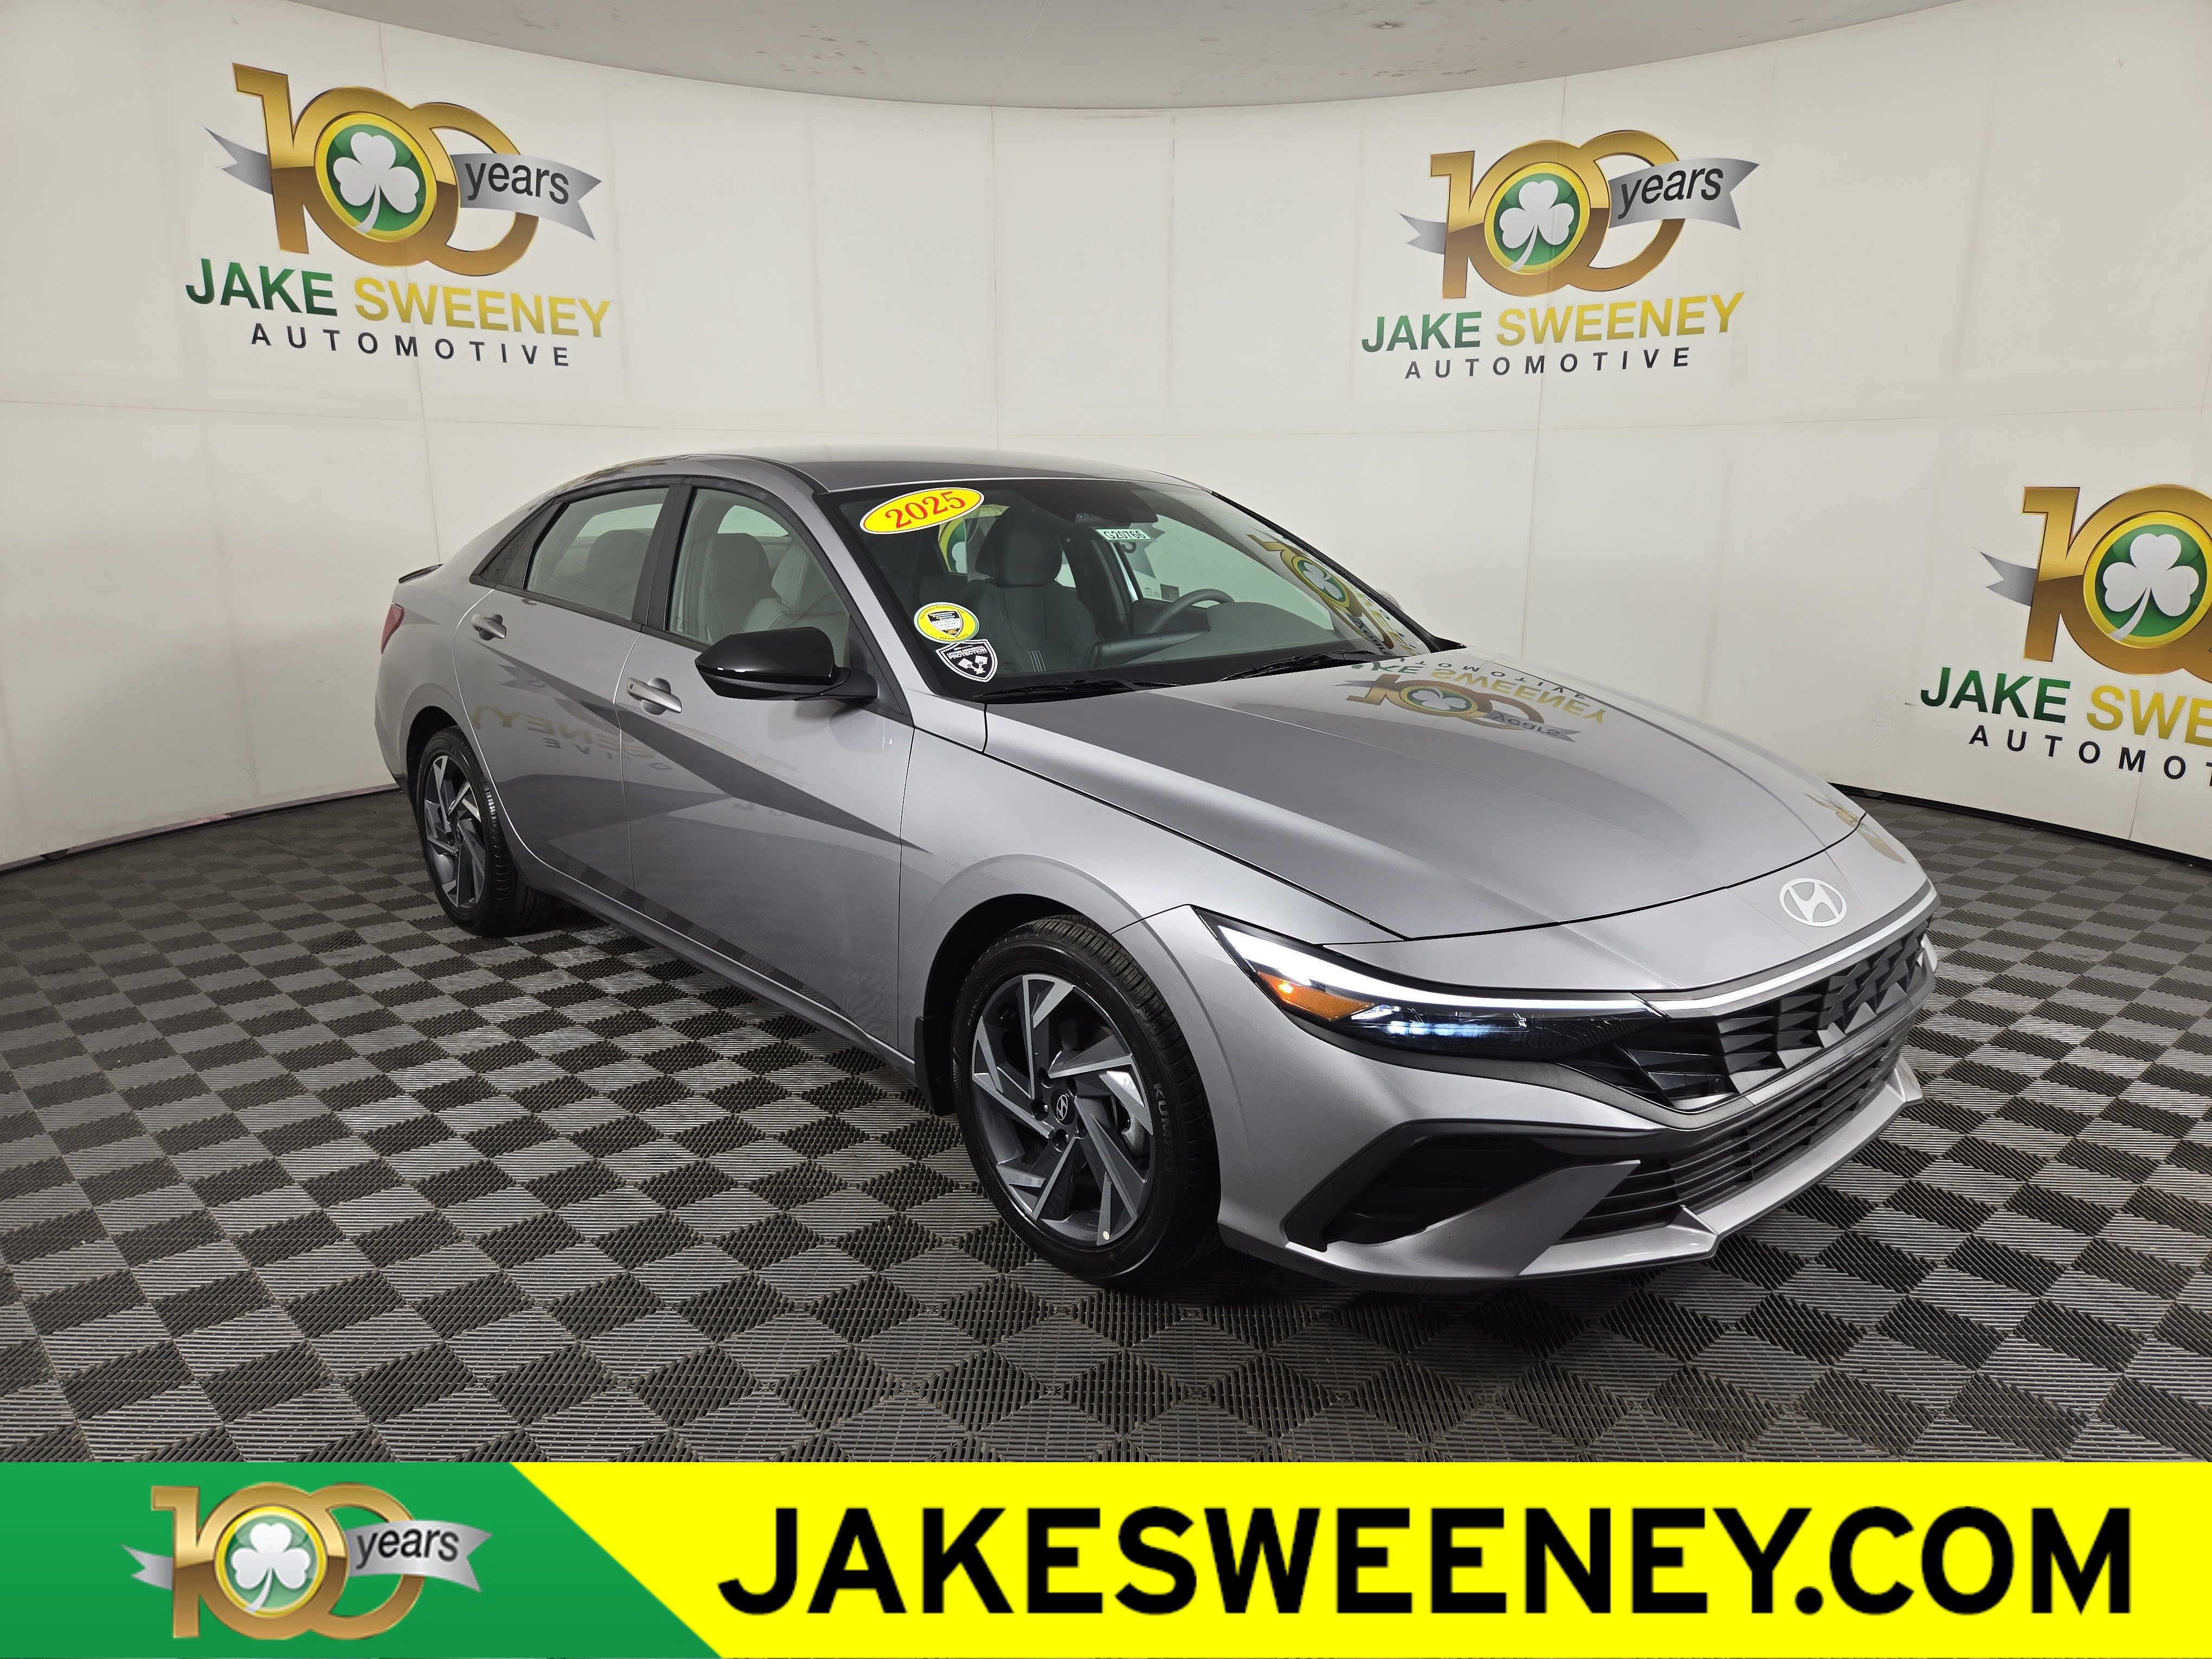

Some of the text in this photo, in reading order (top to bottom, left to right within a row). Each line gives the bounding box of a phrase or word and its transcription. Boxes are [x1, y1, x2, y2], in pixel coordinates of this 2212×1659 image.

[233, 62, 539, 276] 100
[465, 162, 570, 204] years
[1618, 168, 1723, 219] years
[1430, 130, 1686, 299] 100
[185, 258, 612, 338] JAKE SWEENEY
[1361, 292, 1745, 352] JAKE SWEENEY
[252, 323, 569, 366] AUTOMOTIVE
[1405, 347, 1689, 379] AUTOMOTIVE
[885, 491, 966, 529] 2025
[1103, 531, 1146, 539] G20766
[2021, 484, 2212, 684] 10
[948, 648, 987, 659] PROTECTION
[1920, 667, 2070, 724] JAKE
